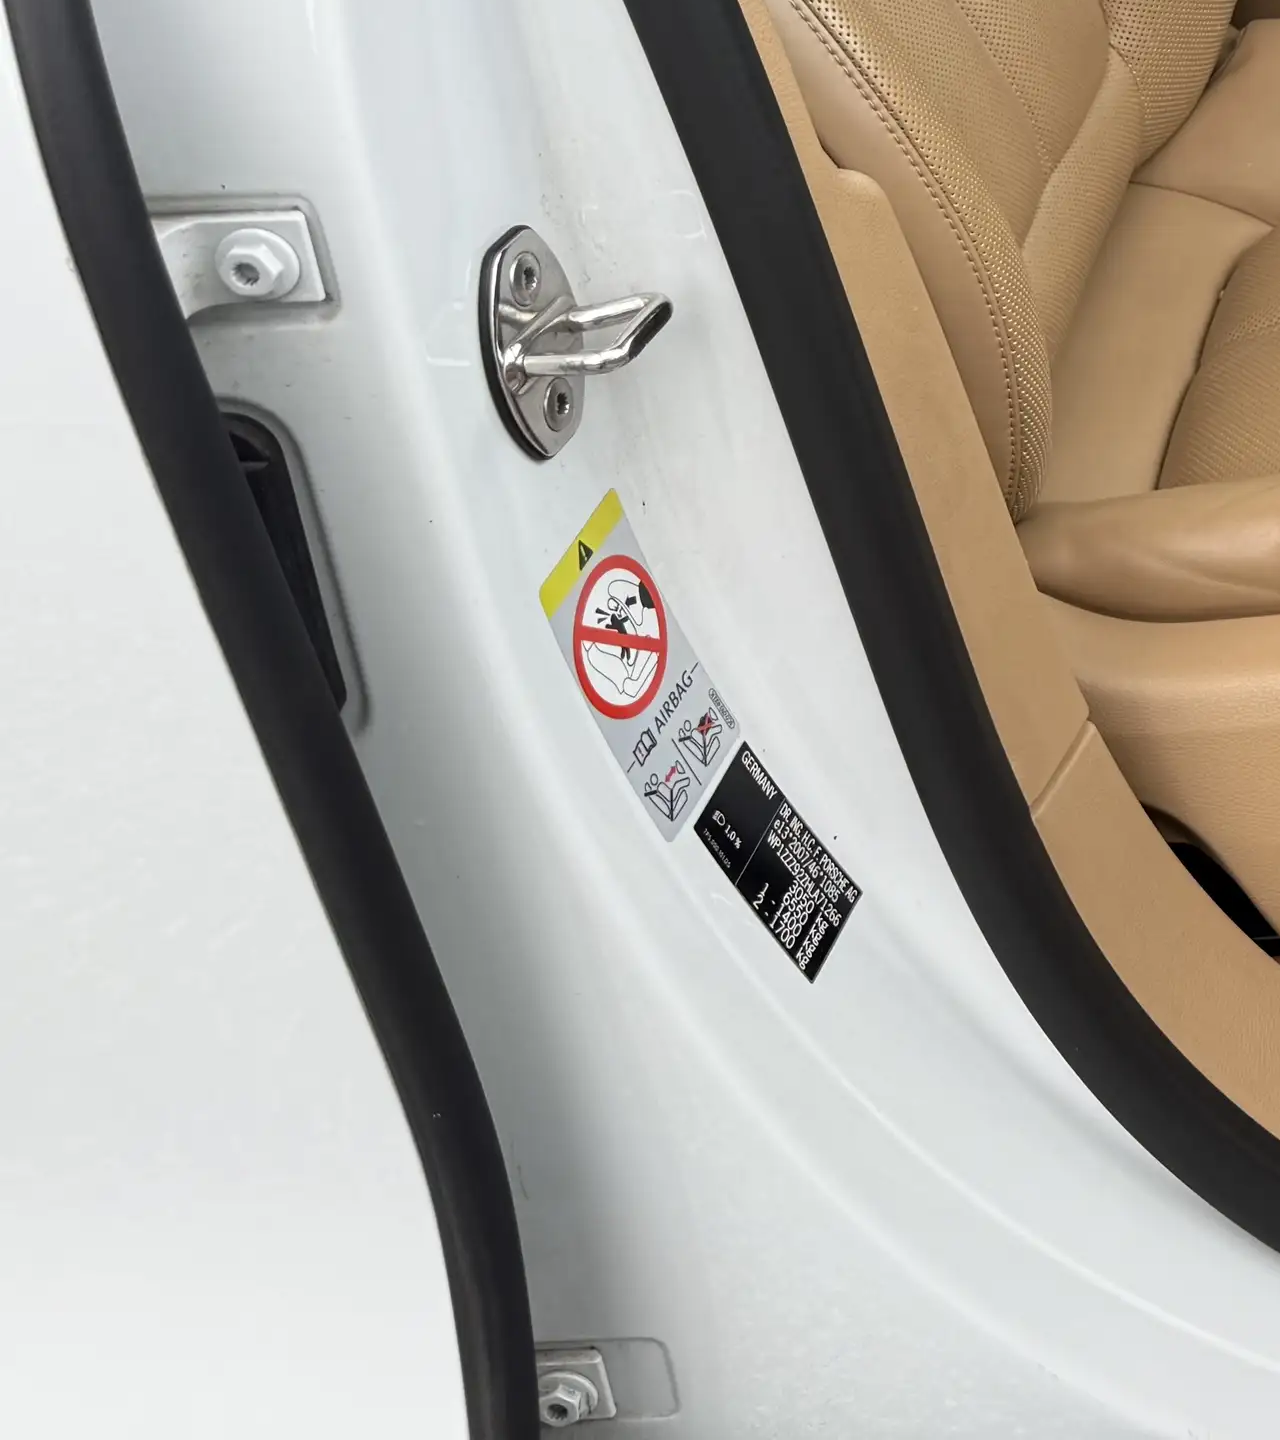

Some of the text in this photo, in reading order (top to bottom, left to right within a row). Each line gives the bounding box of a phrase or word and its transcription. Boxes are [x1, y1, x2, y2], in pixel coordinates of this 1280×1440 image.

[654, 670, 693, 734] AIRBAG
[741, 750, 777, 800] GERMANY
[788, 879, 830, 935] 3050 kg
[818, 853, 849, 893] PORSCHE
[844, 885, 858, 904] AG
[752, 893, 764, 910] 2
[769, 912, 796, 950] 1700
[795, 946, 812, 971] kg
[759, 882, 769, 897] 1
[775, 900, 803, 939] 1400
[801, 935, 818, 959] kg
[782, 891, 823, 949] 6550 kg
